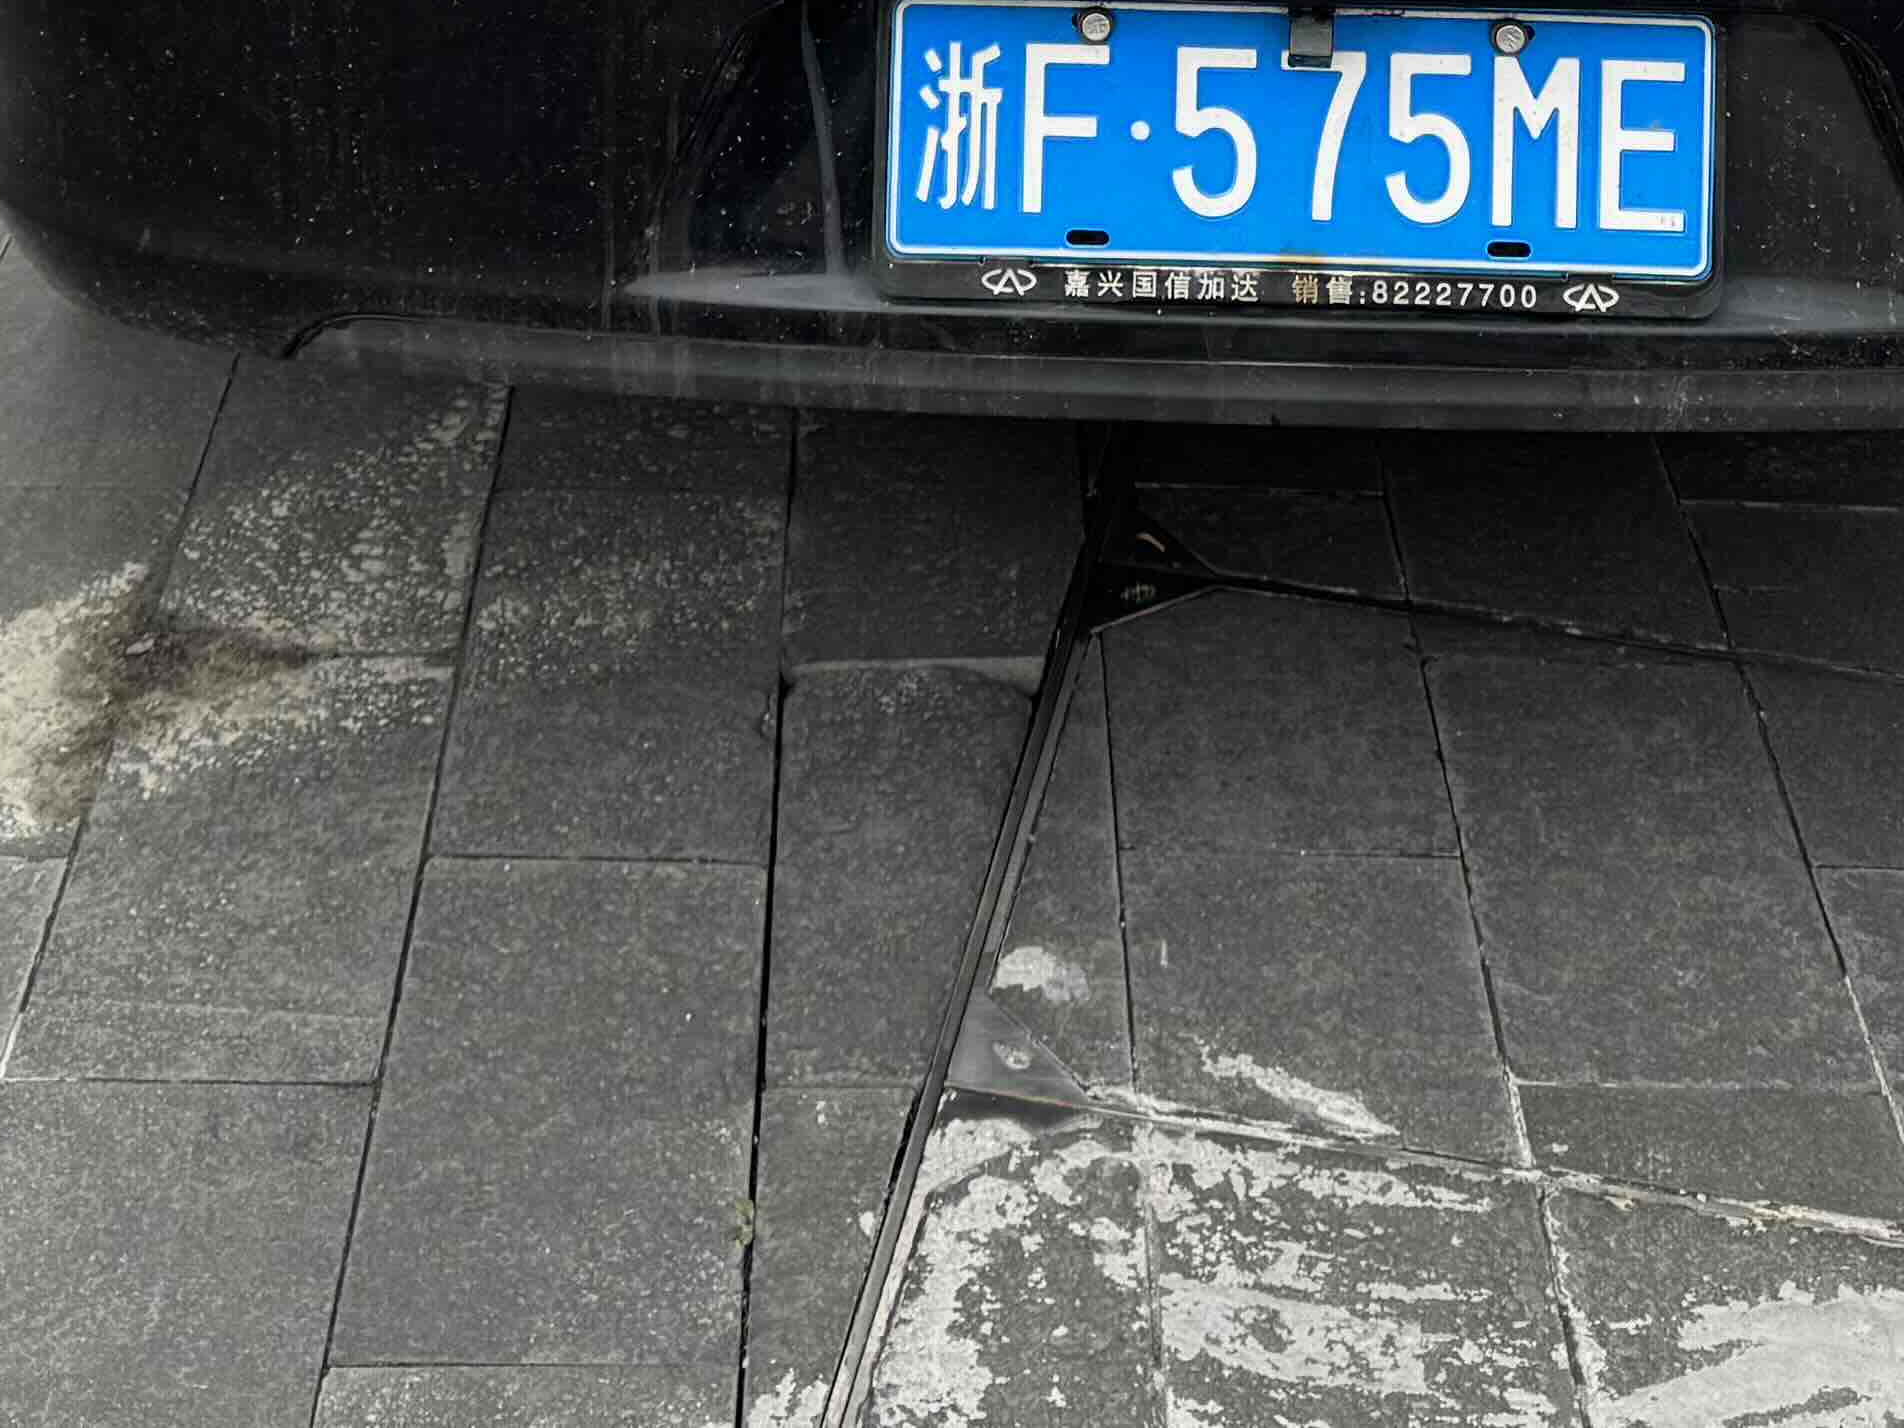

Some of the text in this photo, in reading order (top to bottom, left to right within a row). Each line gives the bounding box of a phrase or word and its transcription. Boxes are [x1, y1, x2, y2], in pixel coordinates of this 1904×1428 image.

[1064, 268, 1260, 303] 嘉兴国信加达
